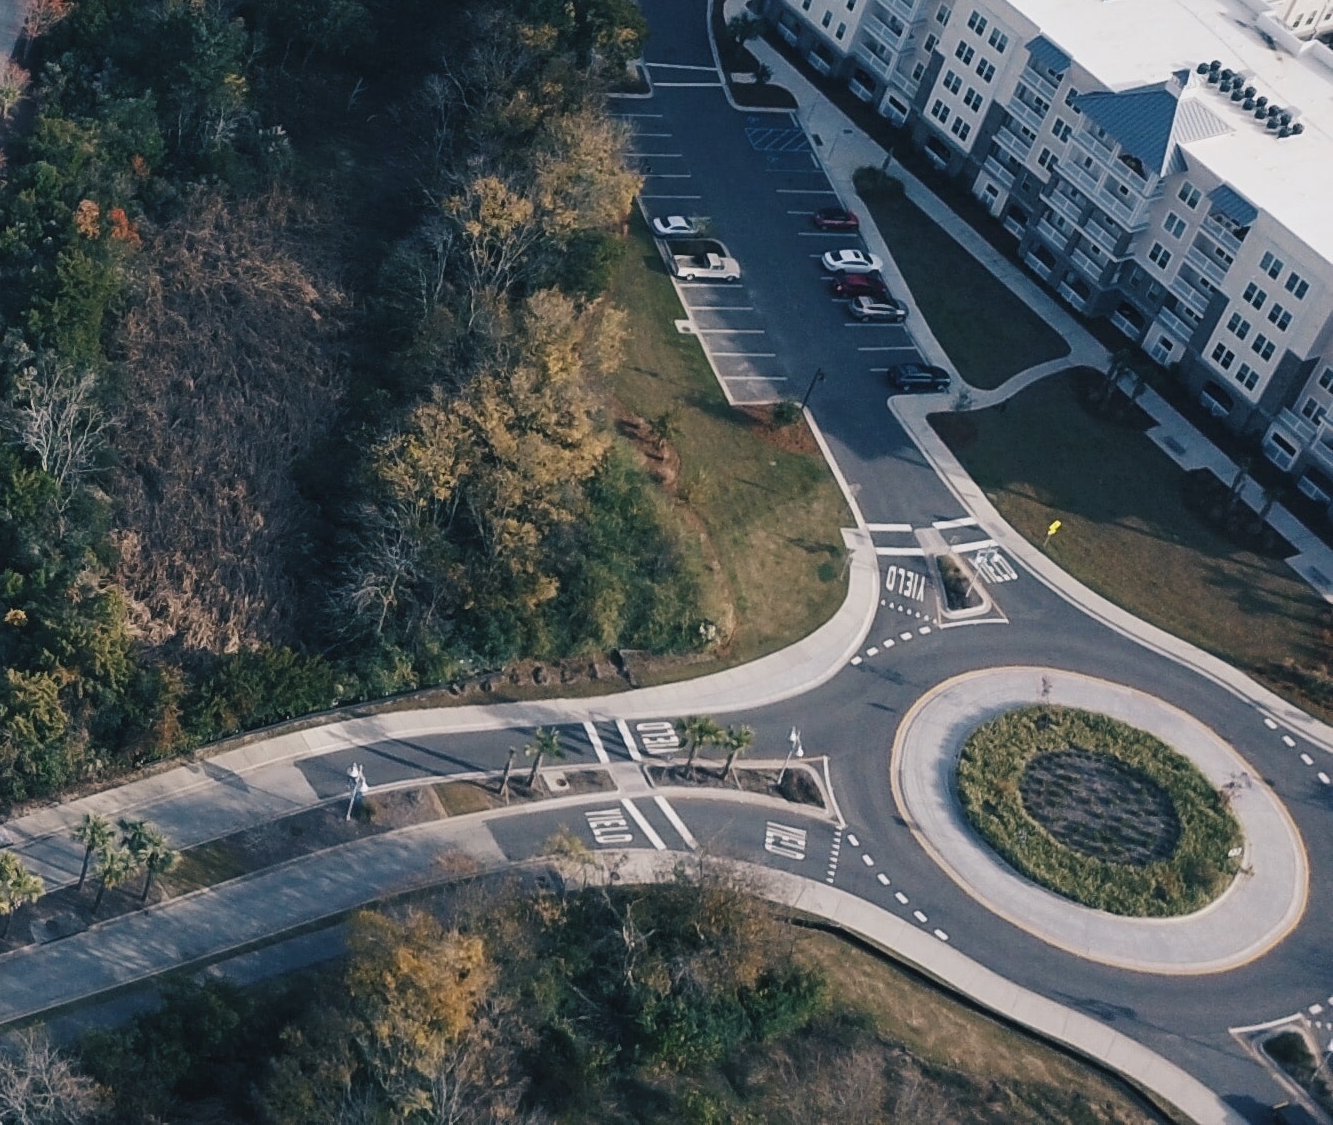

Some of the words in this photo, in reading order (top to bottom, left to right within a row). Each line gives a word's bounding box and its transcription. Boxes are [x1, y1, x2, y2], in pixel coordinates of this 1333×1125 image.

[885, 565, 926, 602] YIELD
[636, 721, 683, 755] YIELD
[584, 807, 633, 844] YIELD
[764, 820, 807, 860] YIELD
